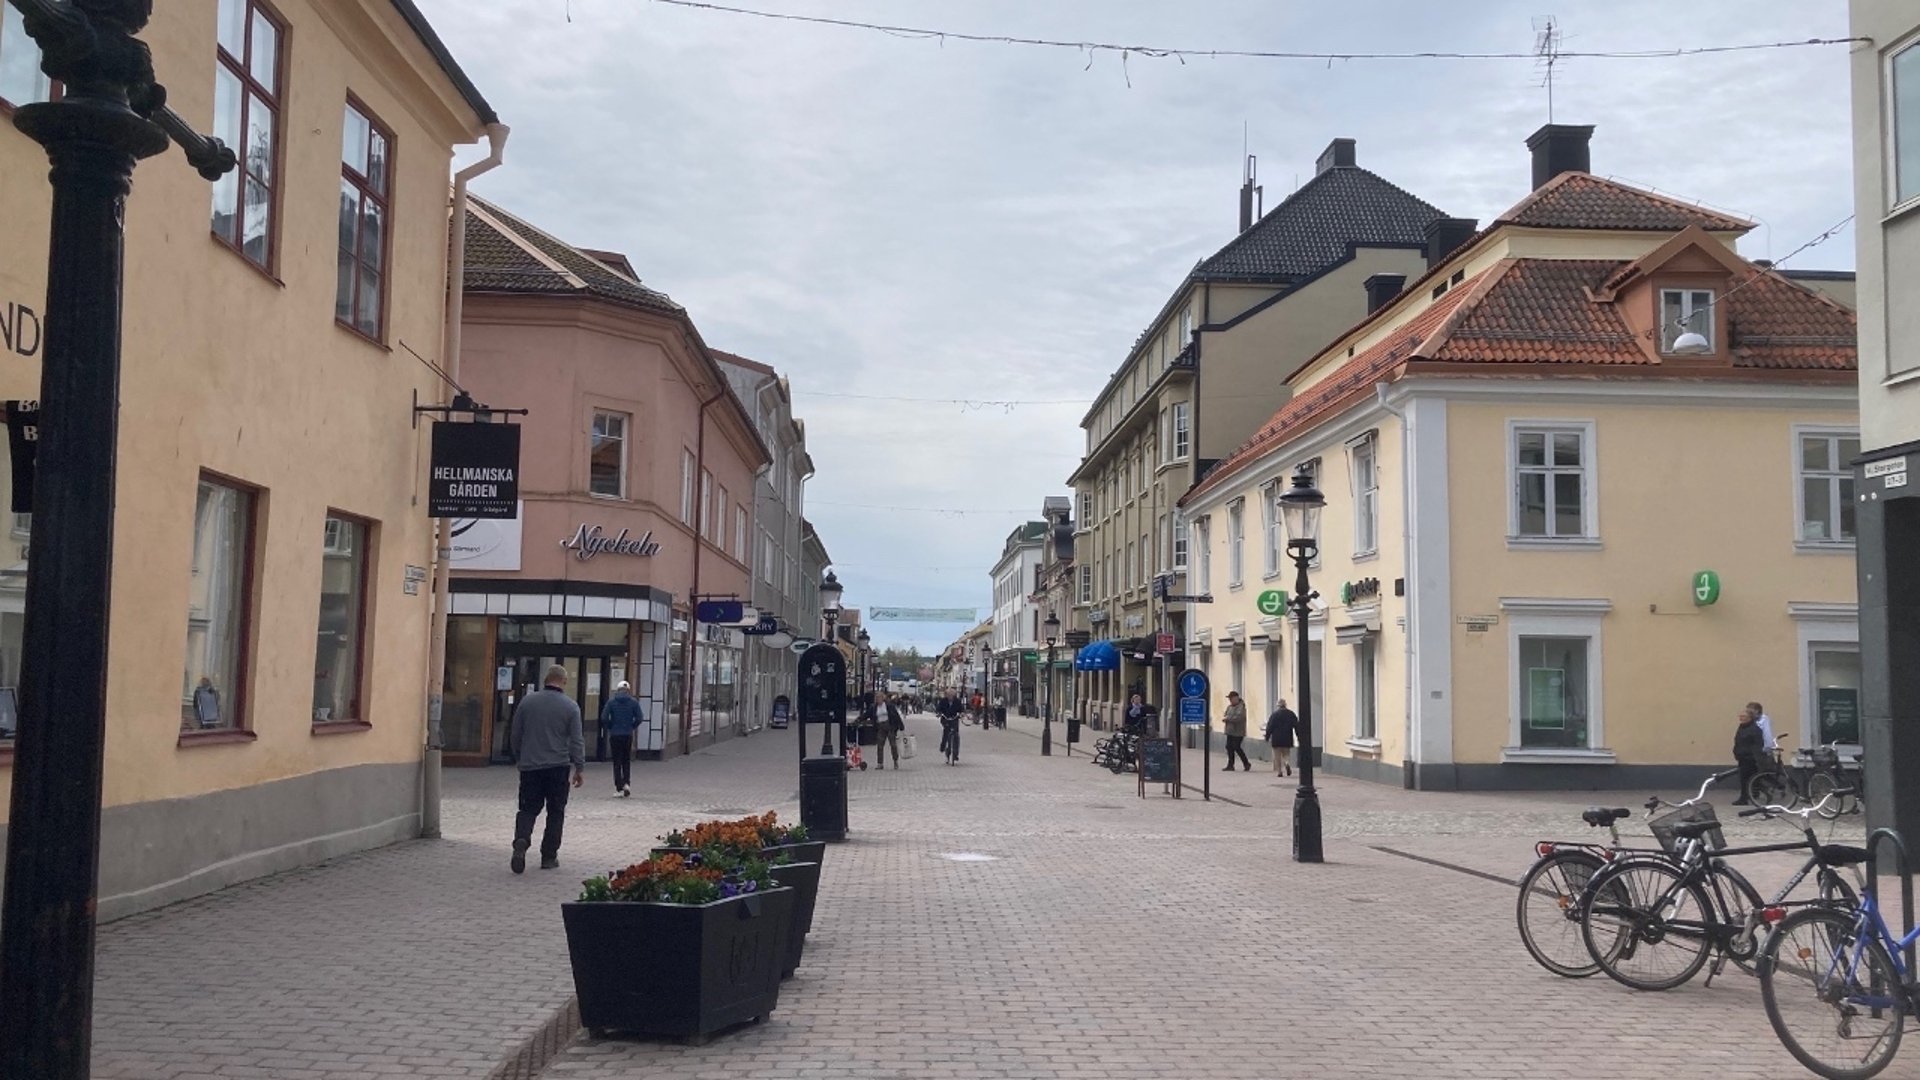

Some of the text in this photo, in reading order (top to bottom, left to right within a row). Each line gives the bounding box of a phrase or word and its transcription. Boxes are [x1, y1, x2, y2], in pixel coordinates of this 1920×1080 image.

[434, 467, 513, 481] HELLMANSKA
[449, 481, 497, 497] GÅRDEN
[559, 526, 662, 560] Nyckeln
